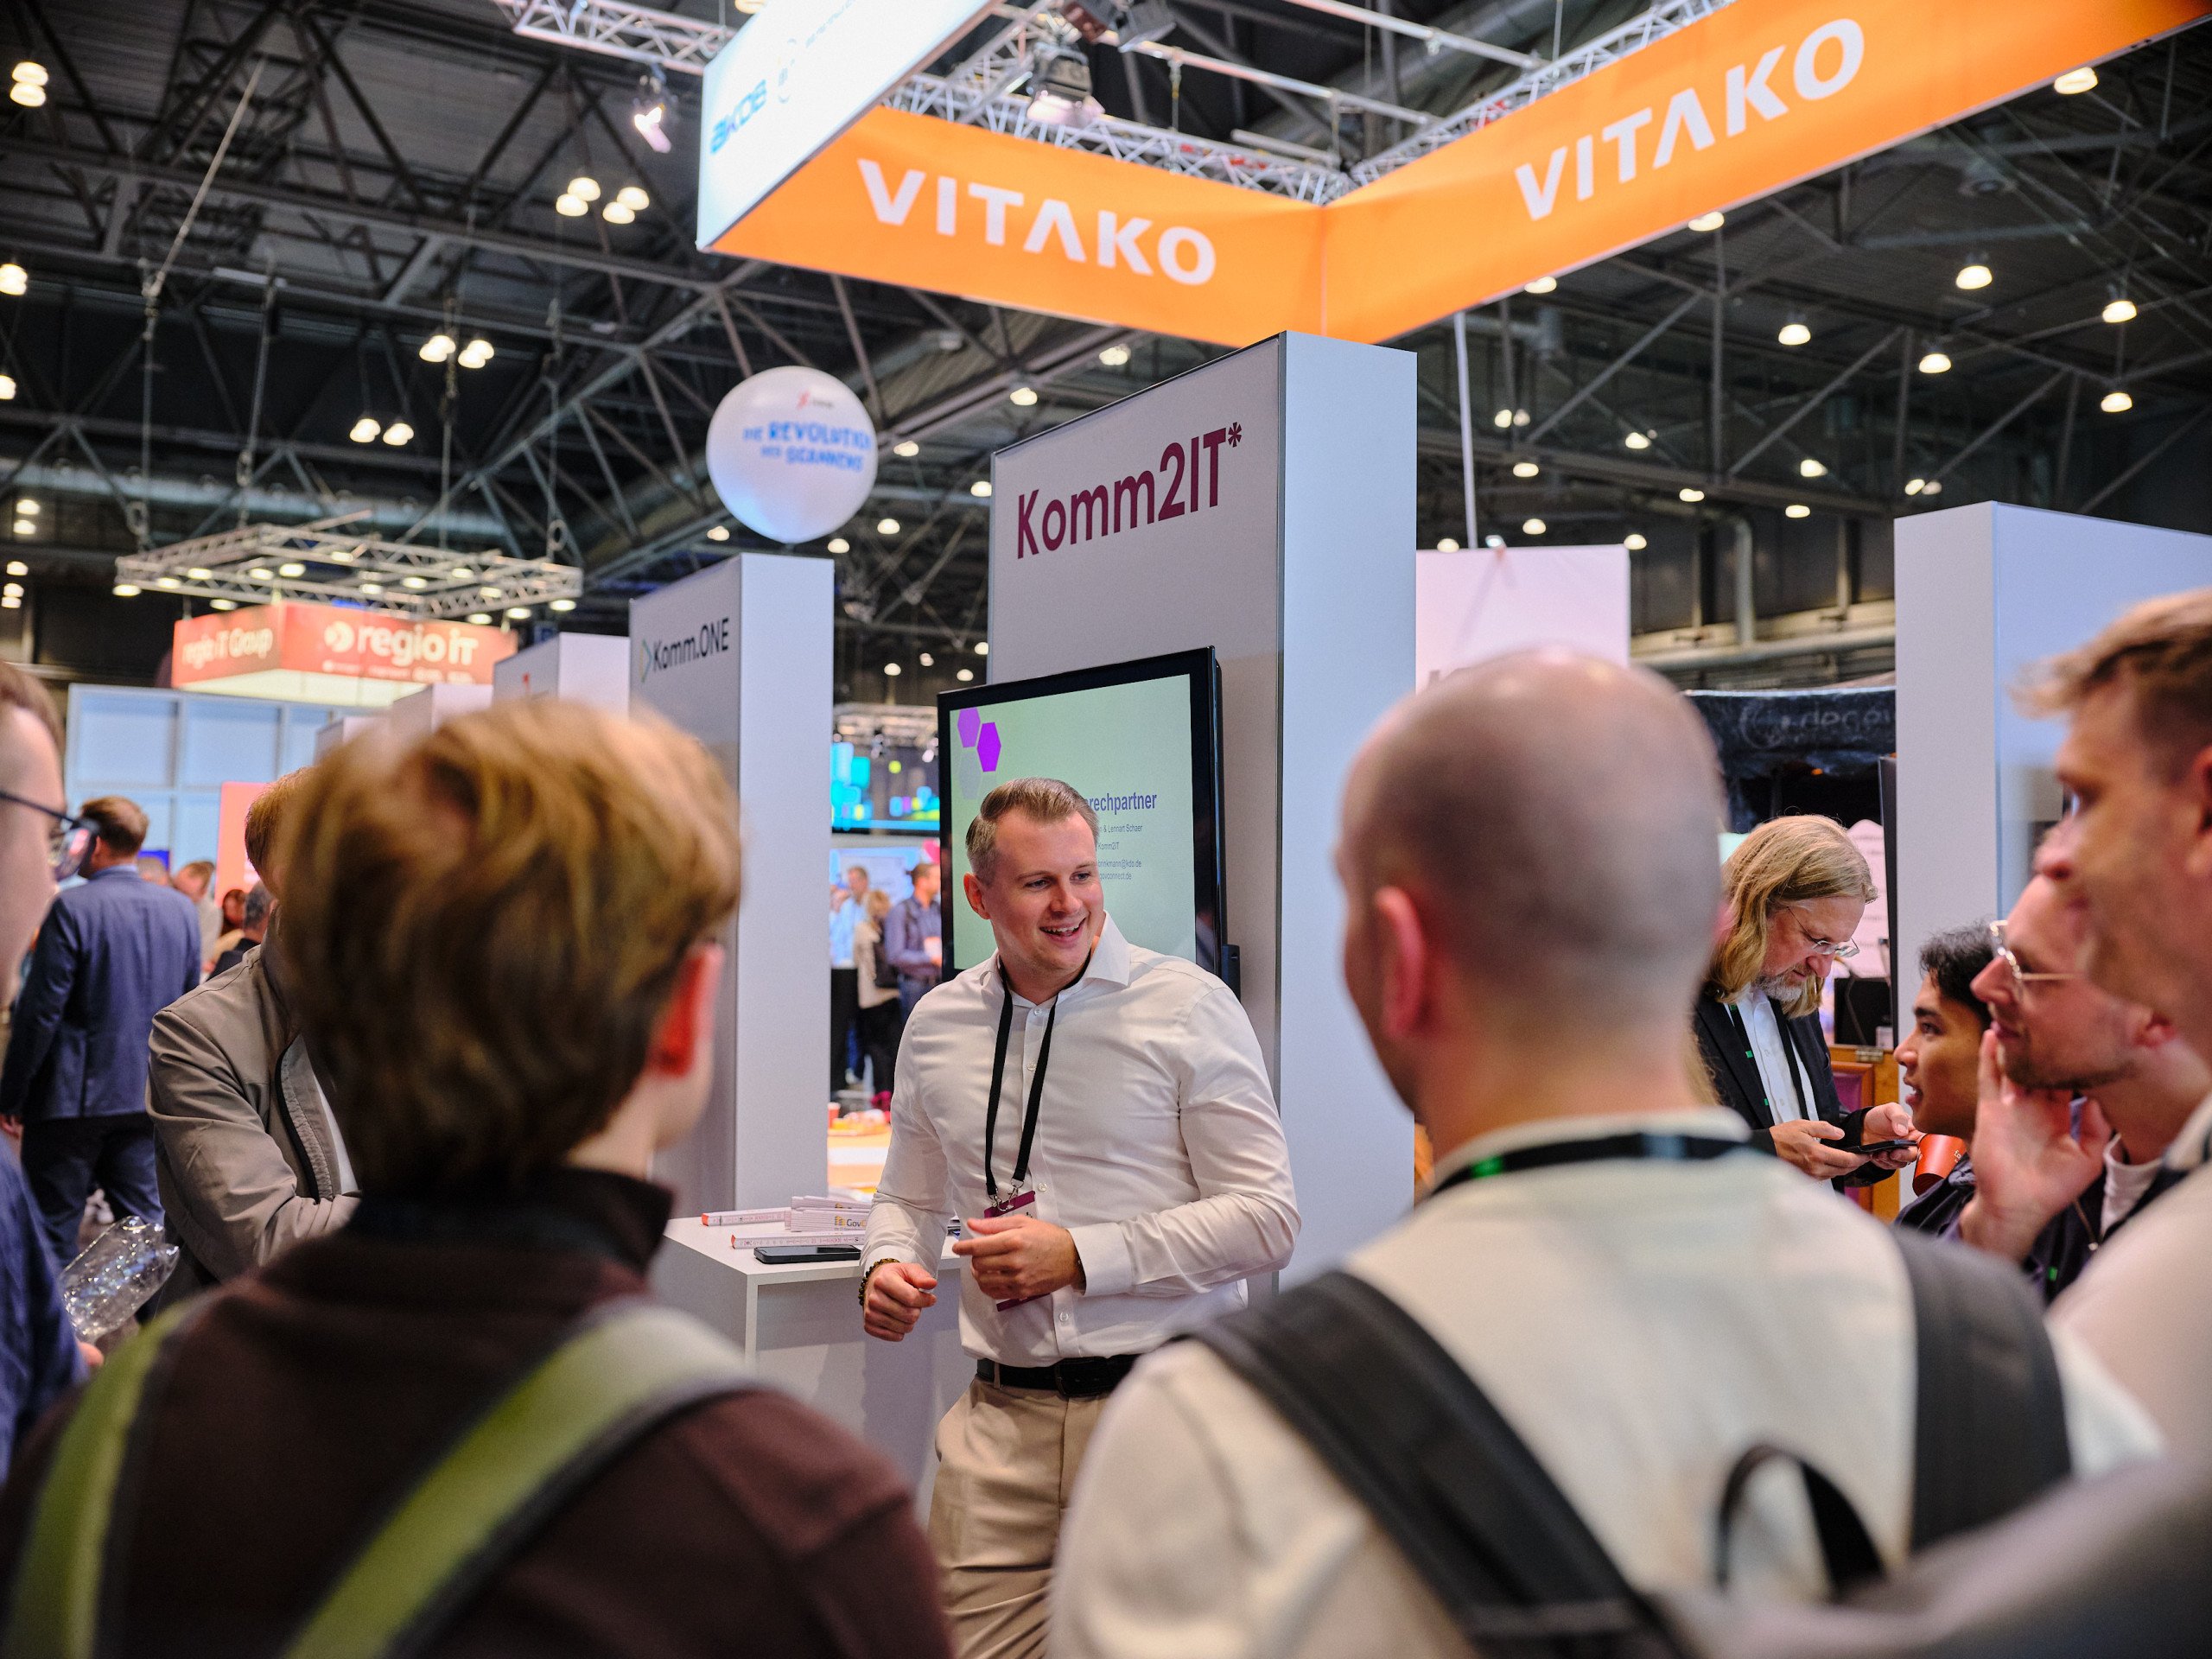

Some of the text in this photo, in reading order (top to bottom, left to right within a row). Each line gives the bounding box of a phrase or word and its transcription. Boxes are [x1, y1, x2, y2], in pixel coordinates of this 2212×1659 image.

[1514, 18, 1864, 221] VITAKO
[857, 159, 1216, 286] VITAKO
[653, 618, 728, 671] Komm.ONE
